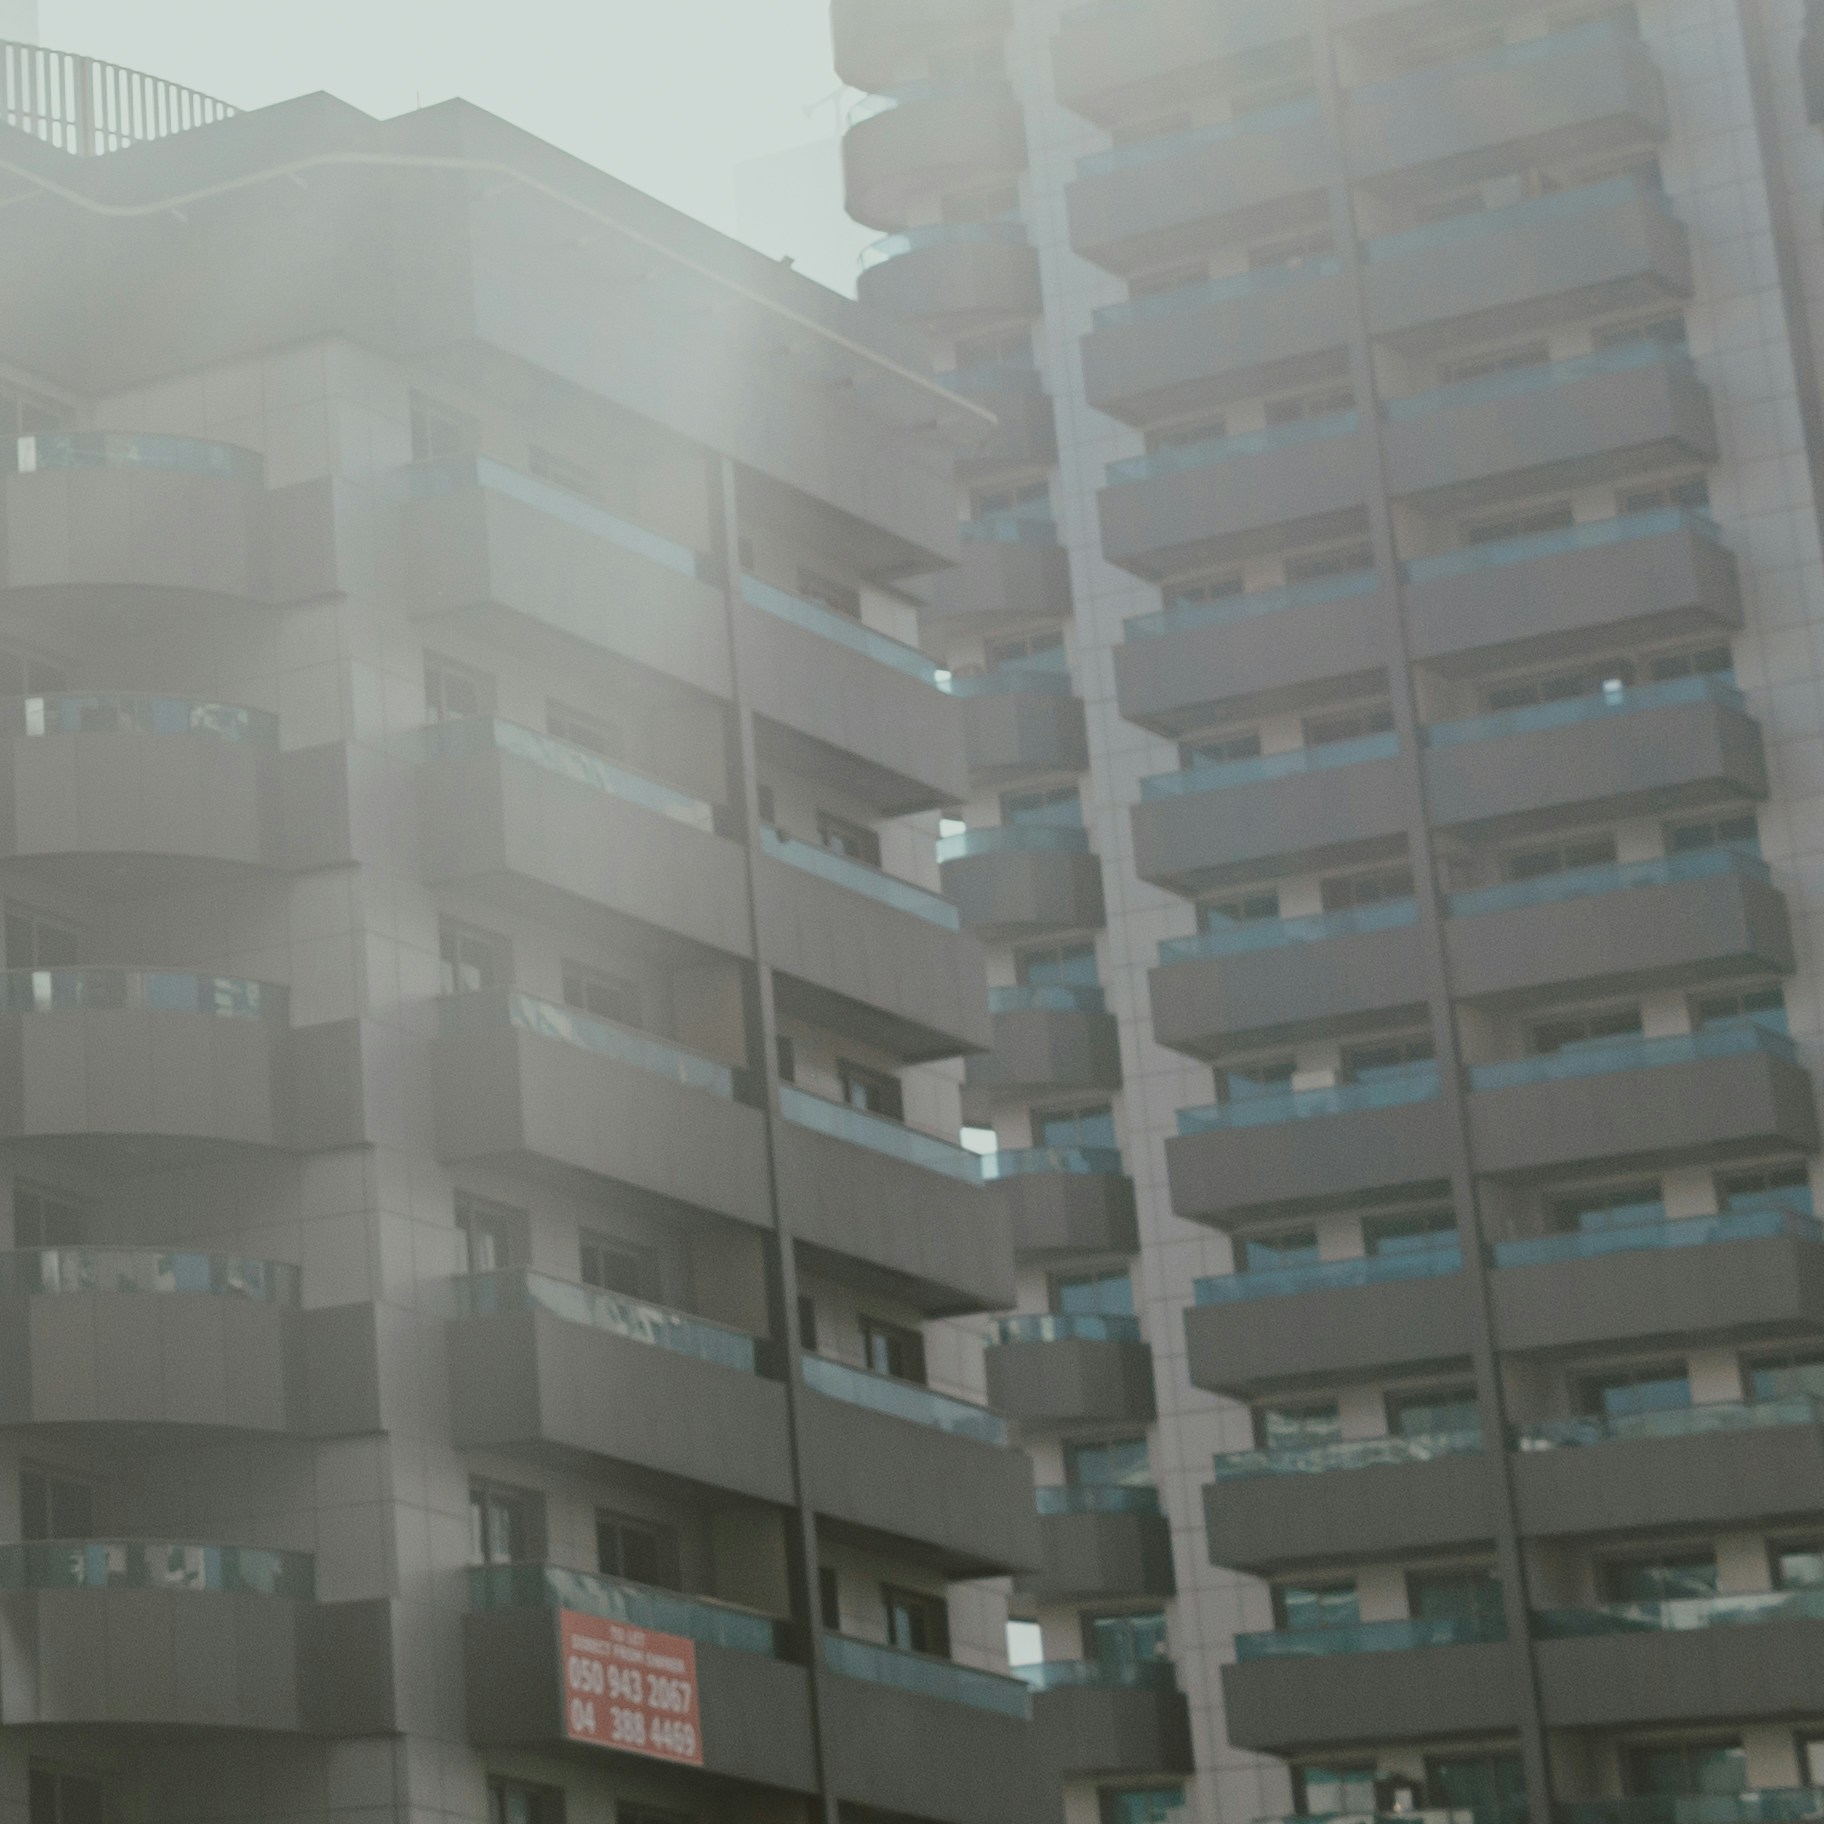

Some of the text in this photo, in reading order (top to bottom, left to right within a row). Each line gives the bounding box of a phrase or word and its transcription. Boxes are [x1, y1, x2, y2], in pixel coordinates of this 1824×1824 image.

[568, 1655, 604, 1696] 050
[607, 1663, 643, 1704] 943
[570, 1697, 596, 1734] 04
